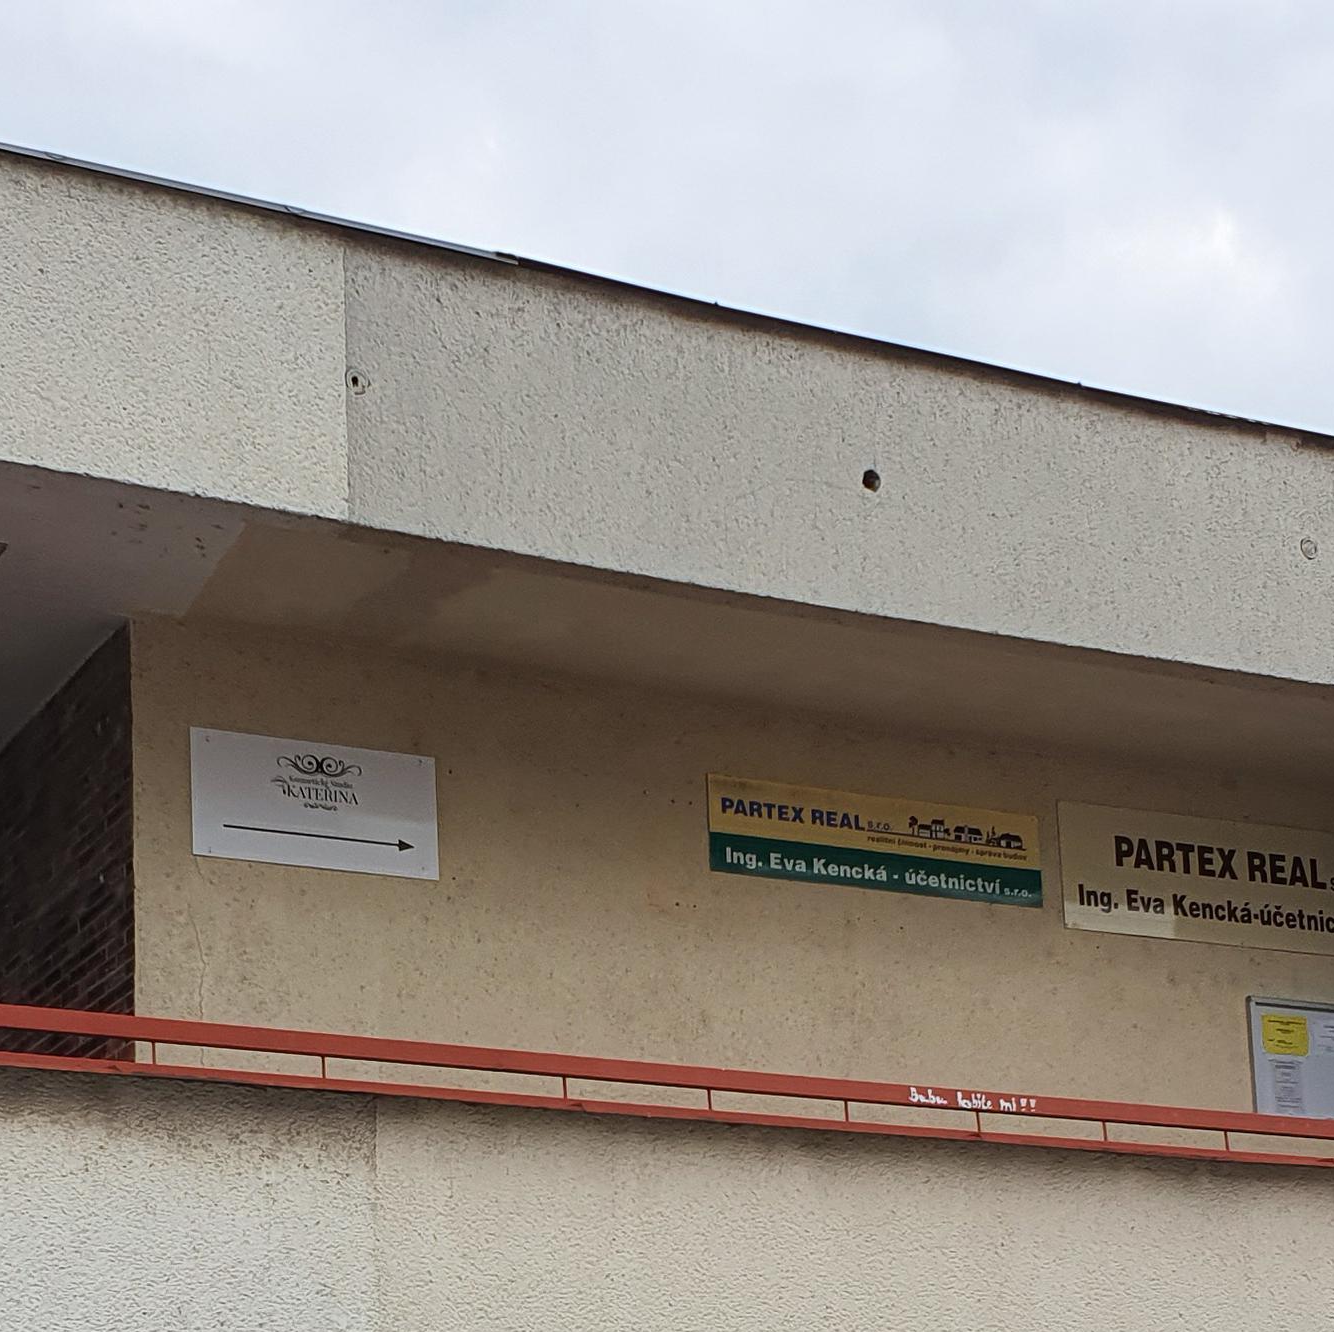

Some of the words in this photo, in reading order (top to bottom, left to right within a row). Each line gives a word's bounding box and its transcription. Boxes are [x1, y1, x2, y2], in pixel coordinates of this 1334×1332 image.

[720, 796, 804, 824] PARTEX
[810, 809, 865, 831] REAL
[725, 847, 762, 870] Ing.
[770, 853, 807, 873] Eva
[813, 855, 887, 882] Kencká
[905, 866, 1001, 895] účetnictví
[1003, 885, 1033, 899] s.r.o.
[1114, 835, 1239, 880] PARTEX
[1246, 851, 1327, 889] REAL
[1078, 884, 1119, 914] Ing.
[1125, 889, 1165, 915] Eva
